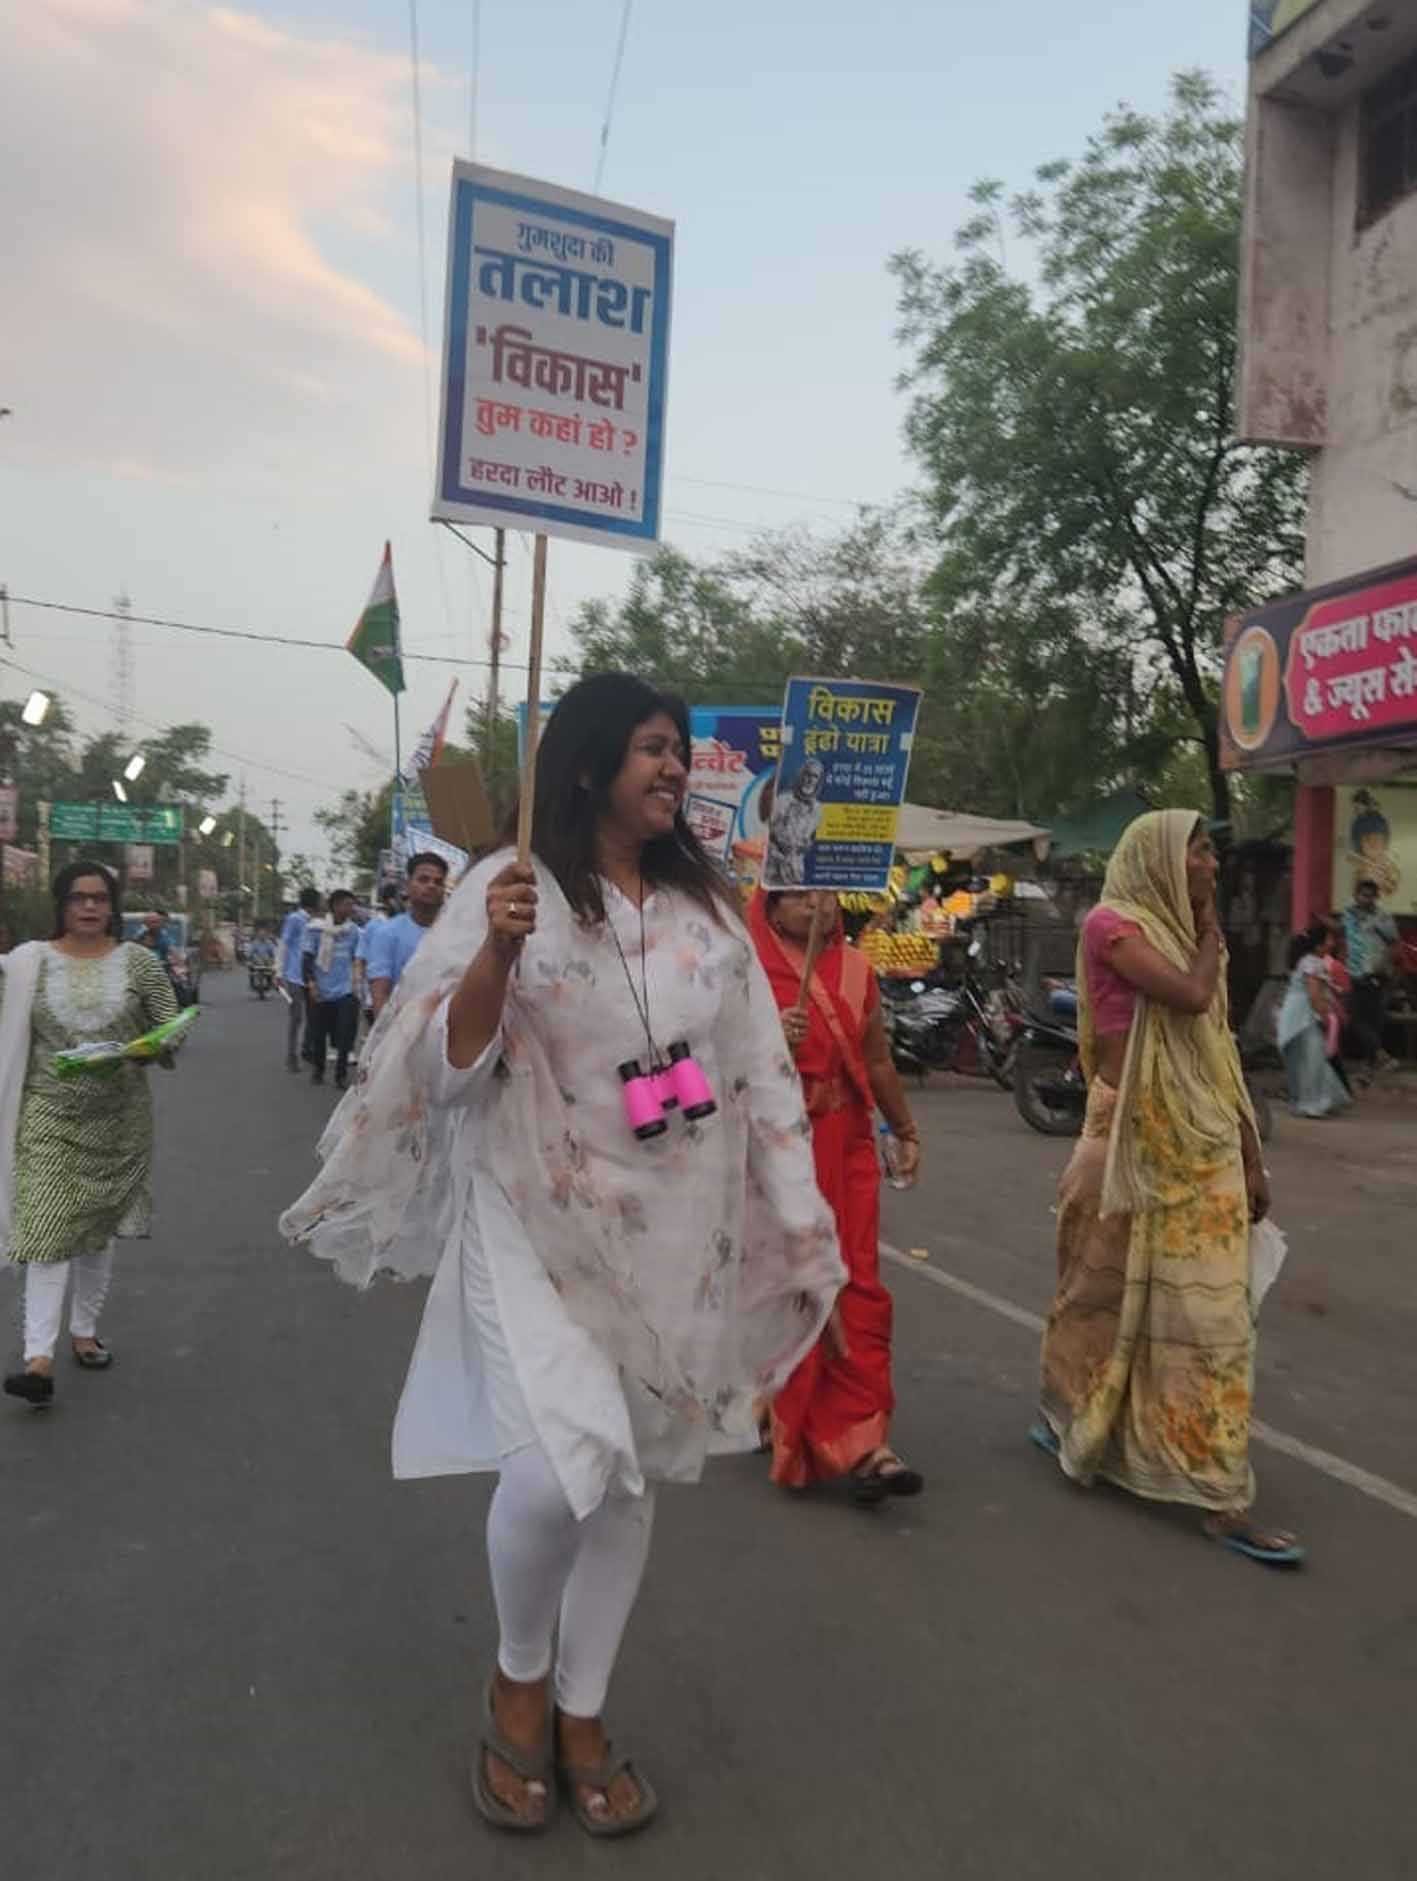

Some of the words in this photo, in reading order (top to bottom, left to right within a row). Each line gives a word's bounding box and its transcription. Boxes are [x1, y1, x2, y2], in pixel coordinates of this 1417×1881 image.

[517, 222, 585, 262] गुमशुदा
[588, 236, 615, 267] की
[474, 245, 651, 335] तलाश
[473, 397, 522, 436] तुम
[527, 409, 583, 446] कहां
[587, 417, 615, 451] हो
[469, 456, 520, 487] हरदा
[525, 465, 569, 496] लौट
[574, 479, 625, 509] आओ
[1299, 615, 1369, 671] एकता
[807, 686, 896, 726] विकास
[1303, 677, 1325, 717] &
